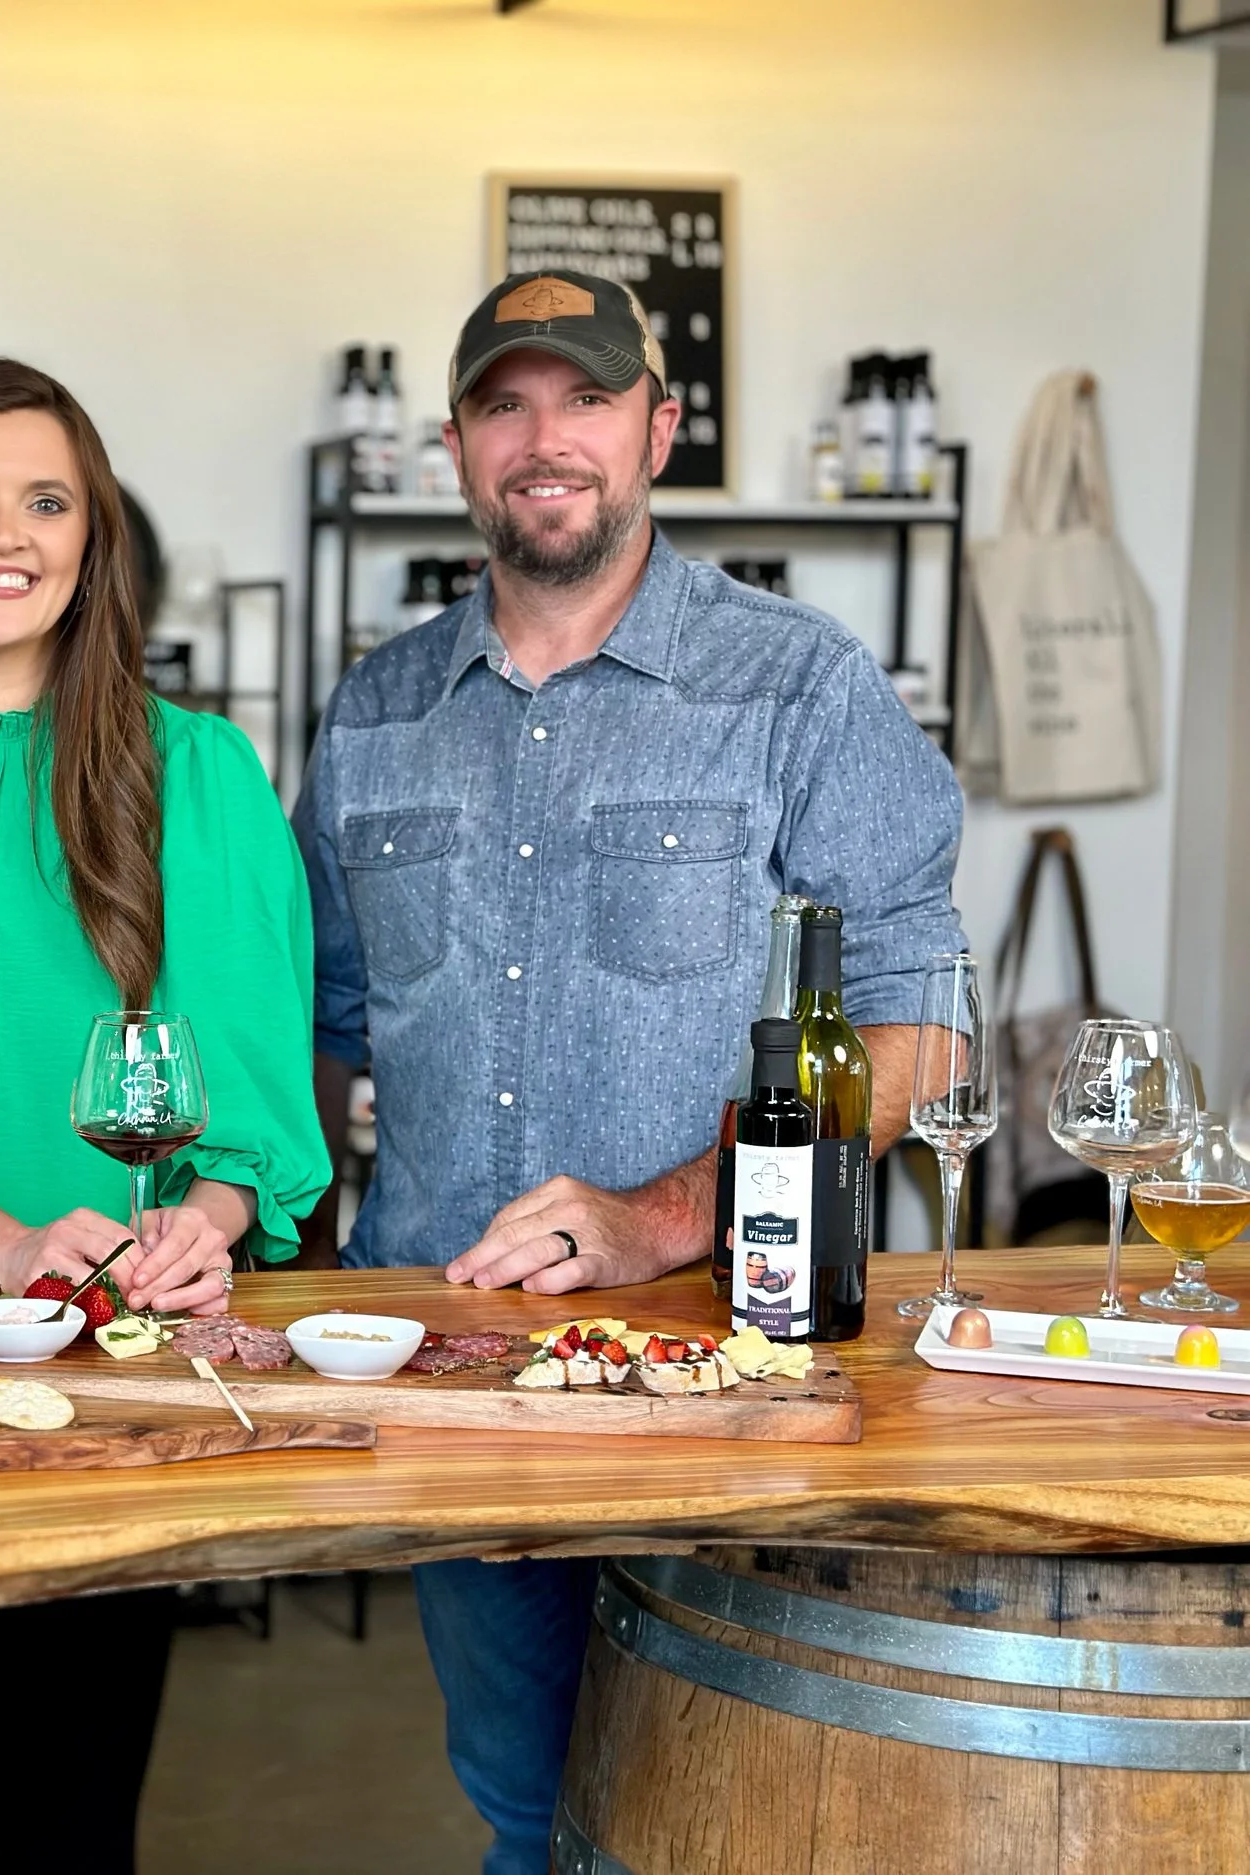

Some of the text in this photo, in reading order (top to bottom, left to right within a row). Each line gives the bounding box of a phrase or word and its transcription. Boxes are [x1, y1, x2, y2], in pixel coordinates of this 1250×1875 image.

[755, 1220, 784, 1228] BALSAMIC
[747, 1229, 793, 1244] Vinegar
[748, 1306, 790, 1315] TRADITIONAL
